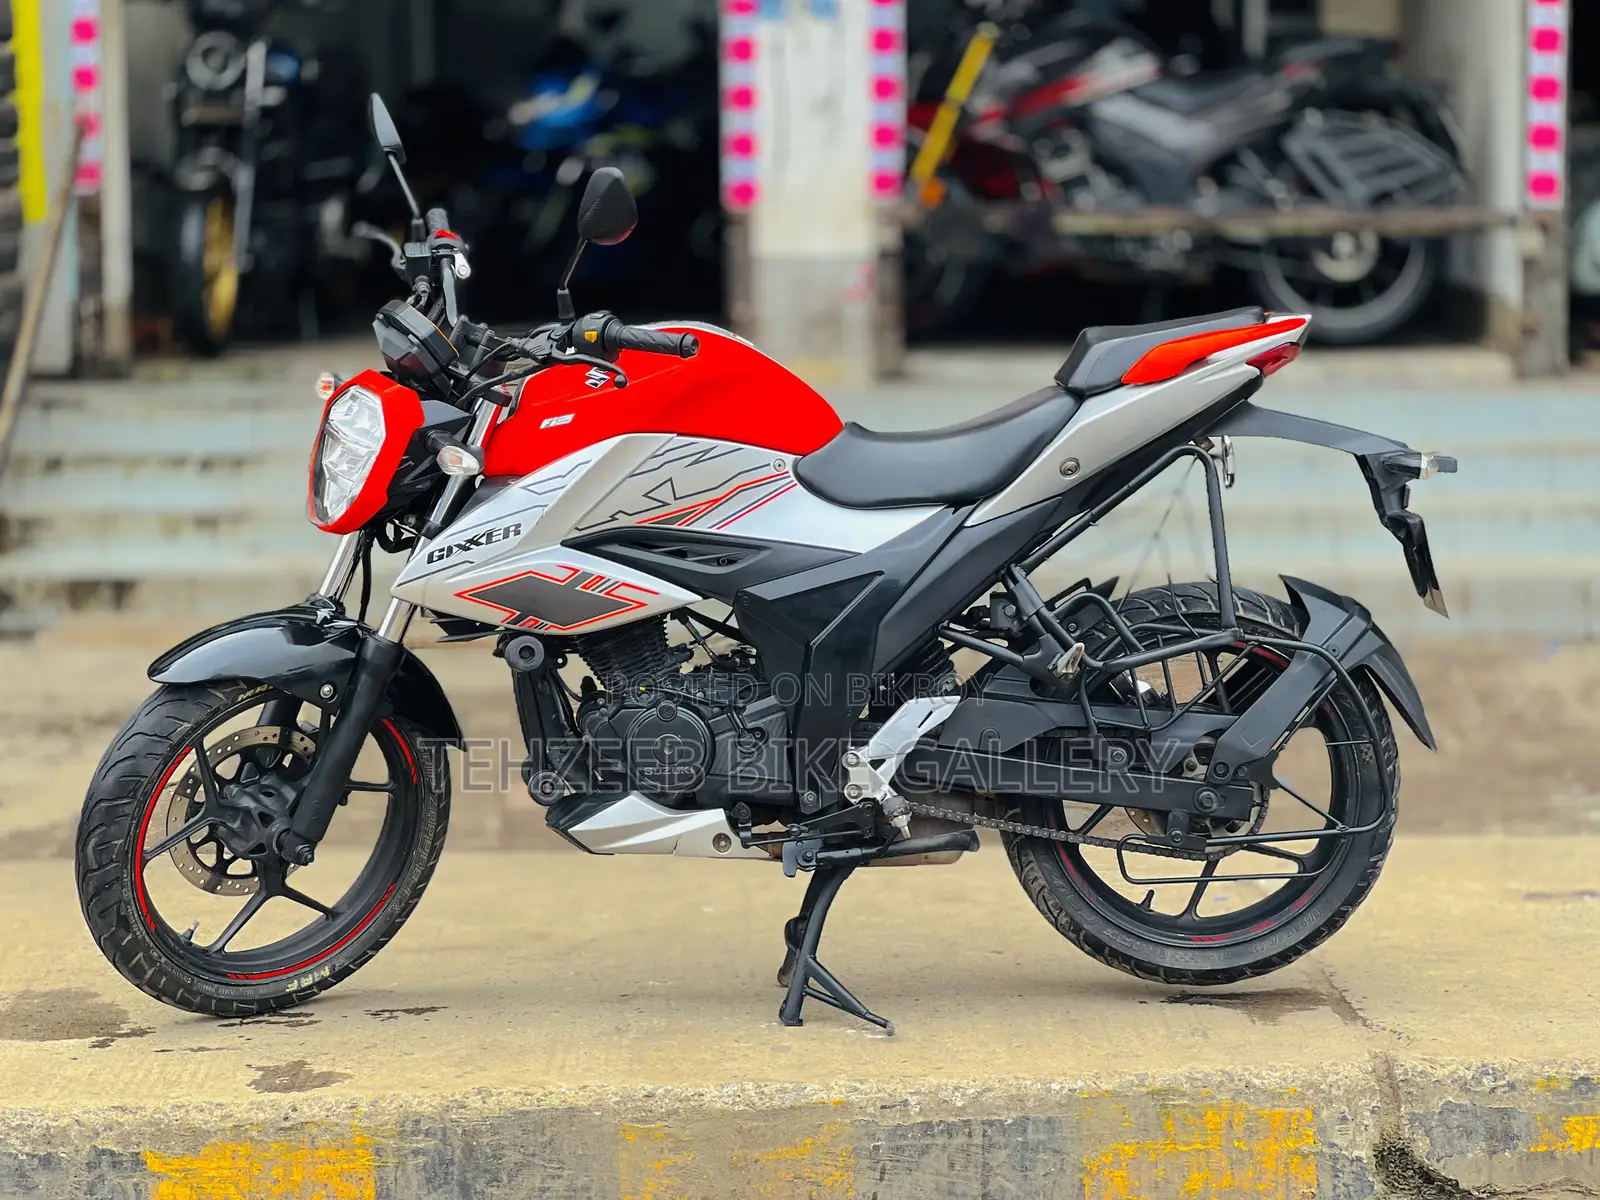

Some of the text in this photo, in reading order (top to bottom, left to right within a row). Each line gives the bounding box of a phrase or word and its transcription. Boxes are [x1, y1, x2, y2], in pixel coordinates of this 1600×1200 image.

[427, 522, 522, 564] GIXXER
[643, 766, 694, 776] SUZUKI
[285, 965, 331, 993] MRF
